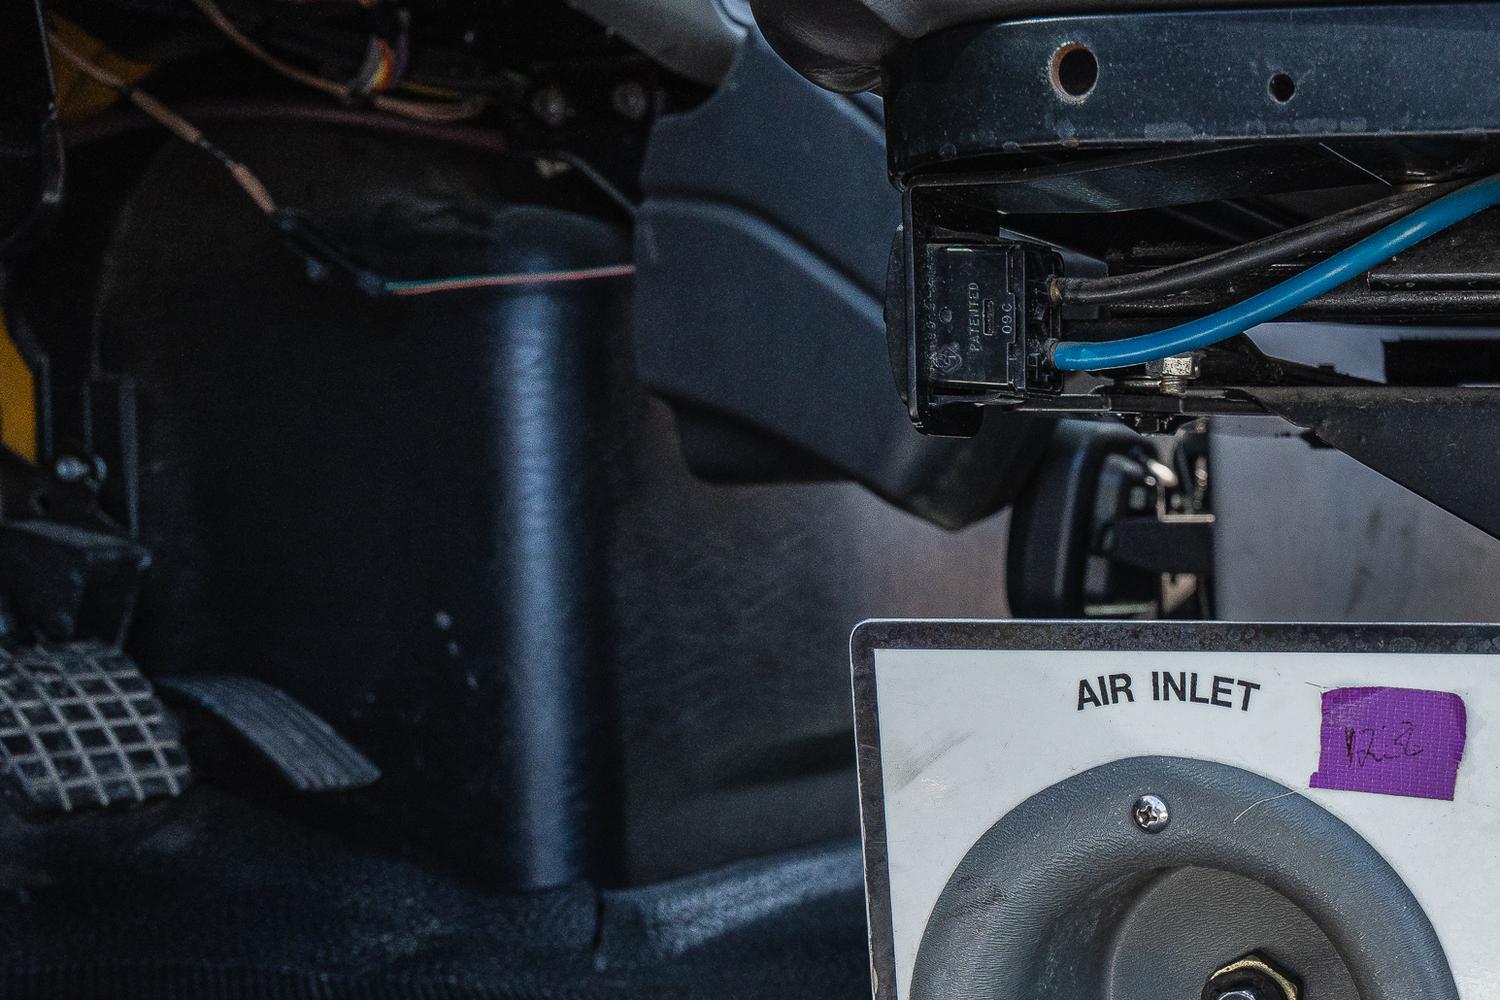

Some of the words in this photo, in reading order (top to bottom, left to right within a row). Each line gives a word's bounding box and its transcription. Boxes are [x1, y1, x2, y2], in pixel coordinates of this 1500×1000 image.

[968, 282, 982, 352] PATENTED
[1077, 672, 1134, 711] AIR
[1152, 671, 1261, 712] INLET
